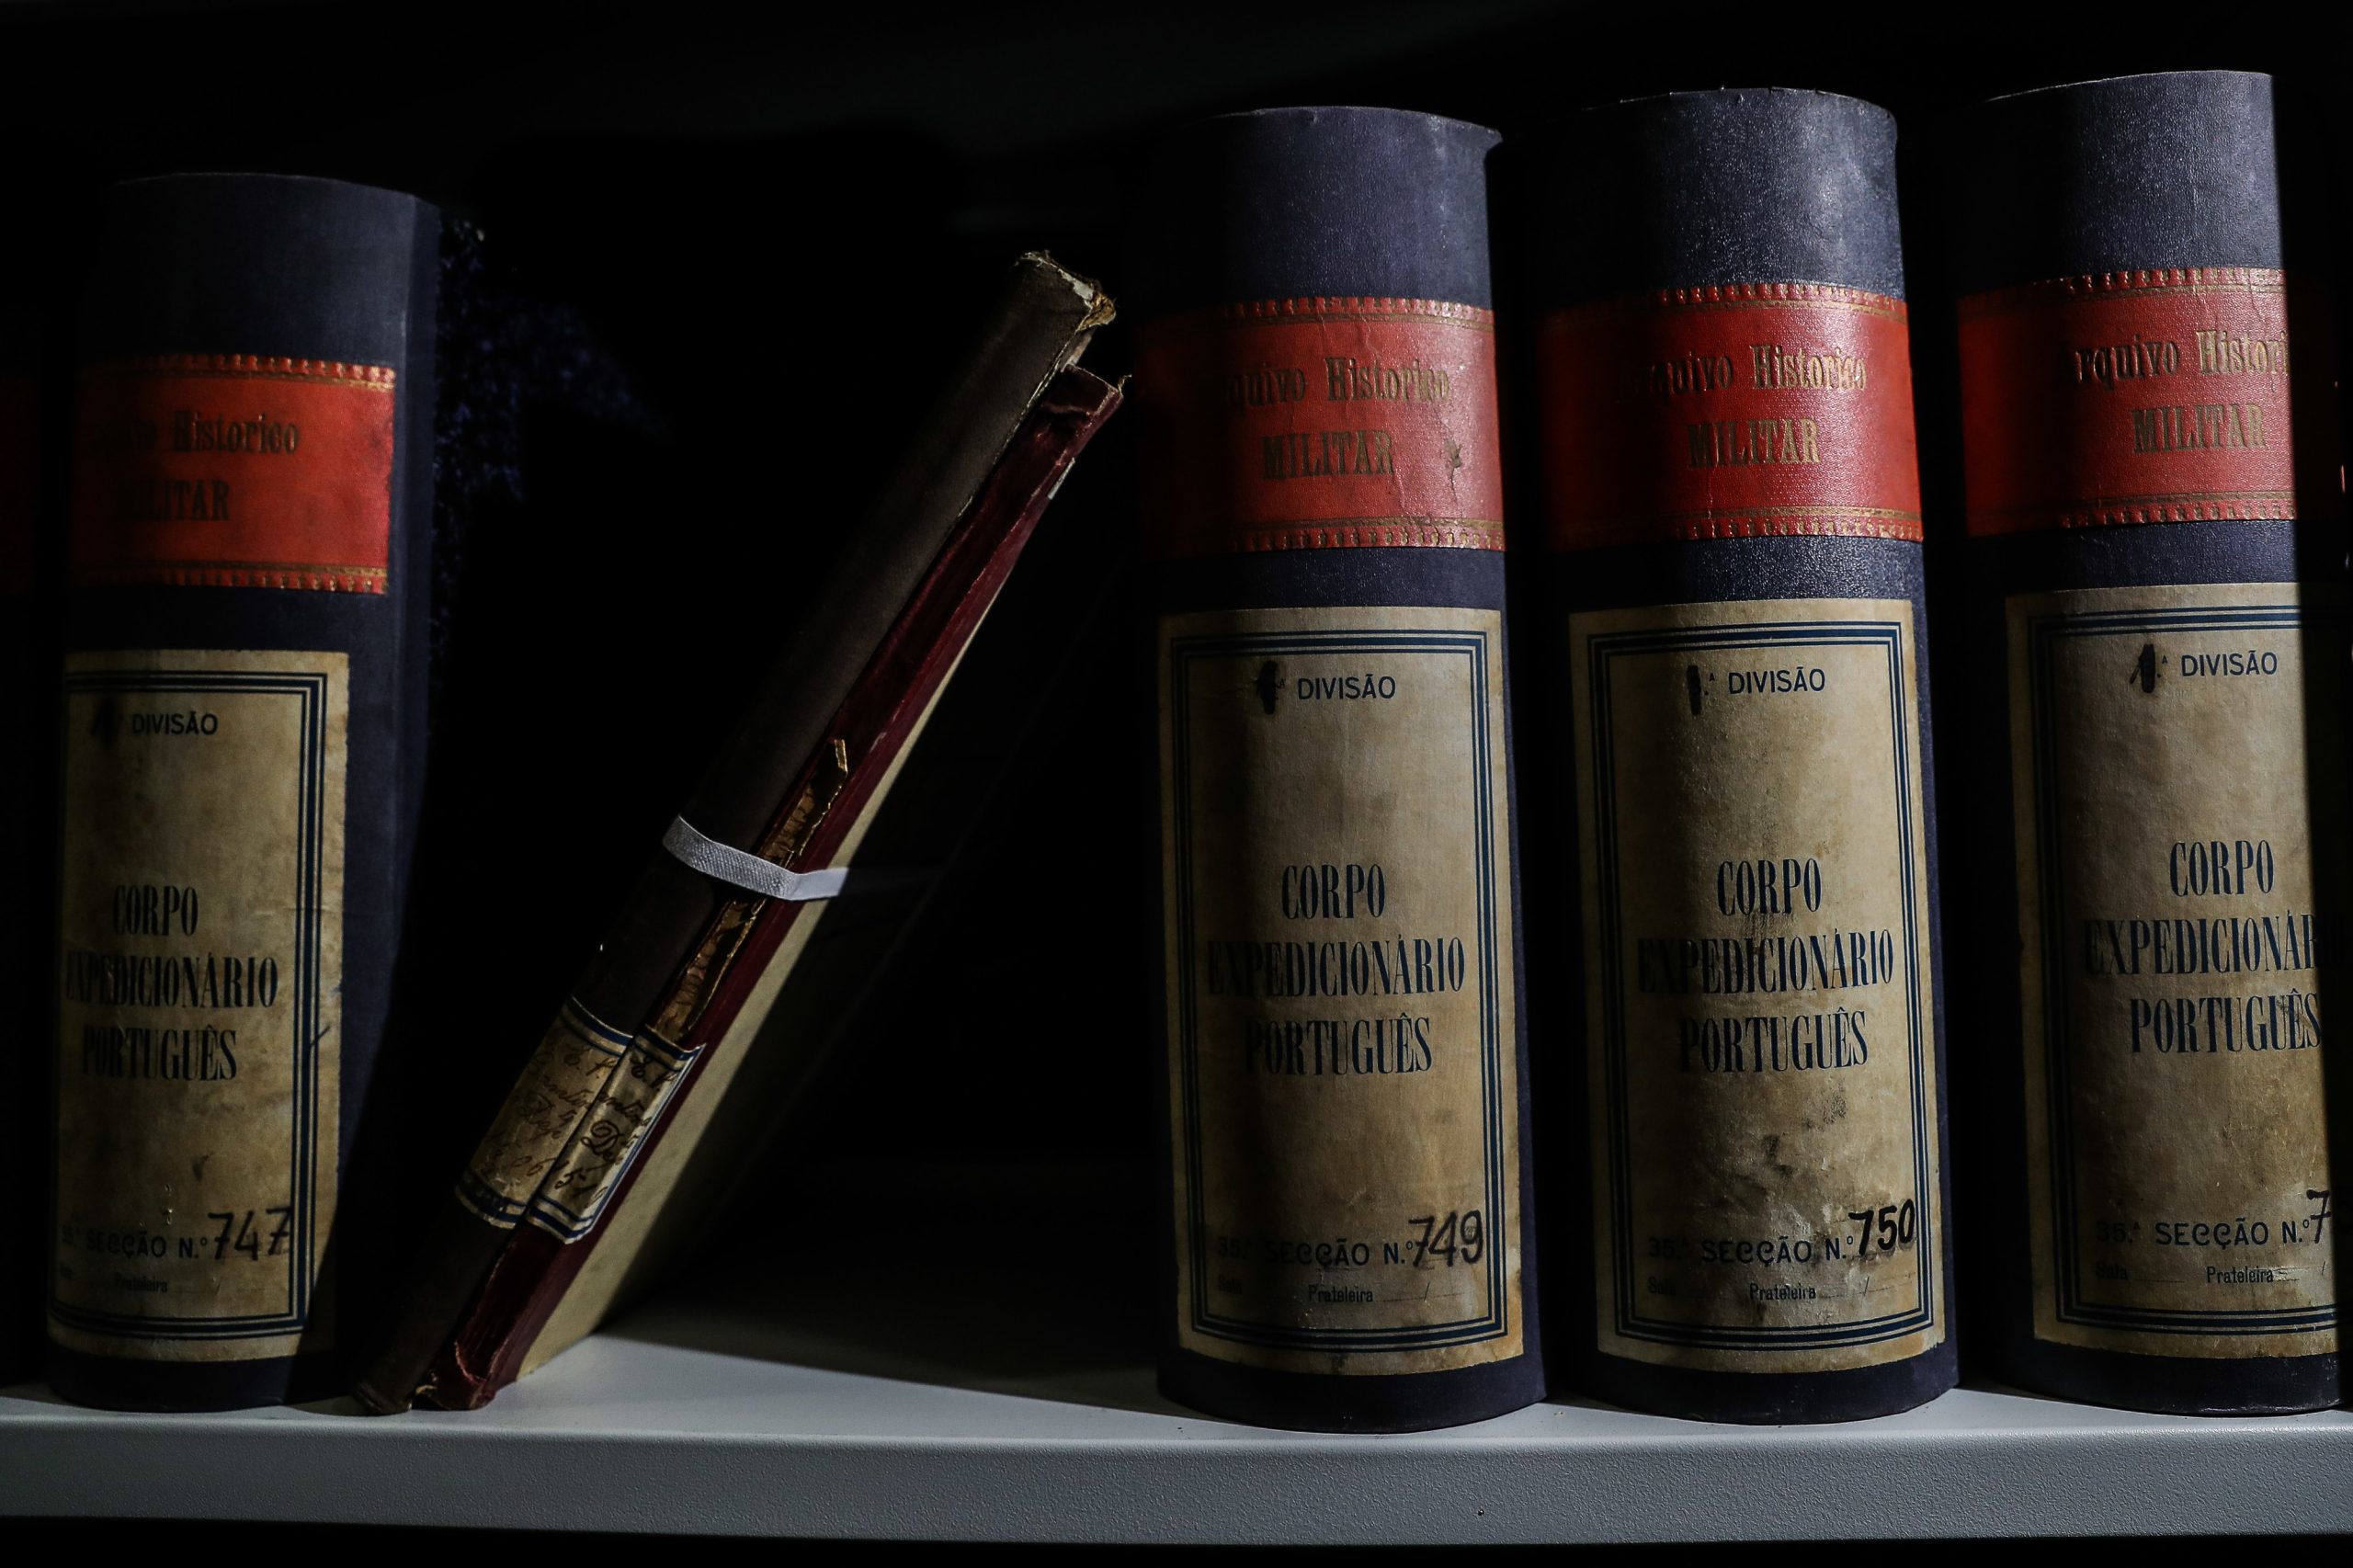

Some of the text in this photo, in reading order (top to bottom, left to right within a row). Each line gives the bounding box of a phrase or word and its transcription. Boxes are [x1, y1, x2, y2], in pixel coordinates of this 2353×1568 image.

[1324, 357, 1450, 402] Historico
[1749, 344, 1868, 392] Historico
[1686, 418, 1821, 469] MILITAR
[2131, 403, 2266, 453] MILITAR
[1263, 431, 1395, 480] MILITAR
[1297, 674, 1396, 700] DIVISÃO
[1729, 666, 1825, 694] DIVISÃO
[2181, 650, 2278, 676] DIVISÃO
[132, 711, 218, 735] DIVISÃO
[1282, 864, 1385, 919] CORPO
[1717, 858, 1822, 916] CORPO
[2169, 839, 2274, 897] CORPO
[113, 885, 198, 936] CORPO
[66, 950, 278, 1007] EXPEDICIONÁRIO
[1207, 934, 1465, 996] EXPEDICIONÁRIO
[1637, 928, 1893, 994] EXPEDICIONÁRIO
[1245, 1012, 1432, 1075] PORTUGUÊS
[1677, 1006, 1868, 1074] PORTUGUÊS
[2130, 988, 2325, 1053] PORTUGUÊS
[84, 1024, 237, 1082] PORTUGUÊS
[86, 1230, 166, 1258] SECÇÃO
[208, 1206, 292, 1260] 747
[1265, 1238, 1370, 1268] SECÇÃO
[1409, 1210, 1483, 1267] 749
[1701, 1236, 1812, 1267] SECÇÃO
[1848, 1199, 1915, 1256] 750
[2155, 1217, 2268, 1249] SECÇÃO
[1309, 1284, 1373, 1302] Prateleira
[1749, 1283, 1816, 1301] Prateleira
[2206, 1266, 2274, 1283] Prateleira
